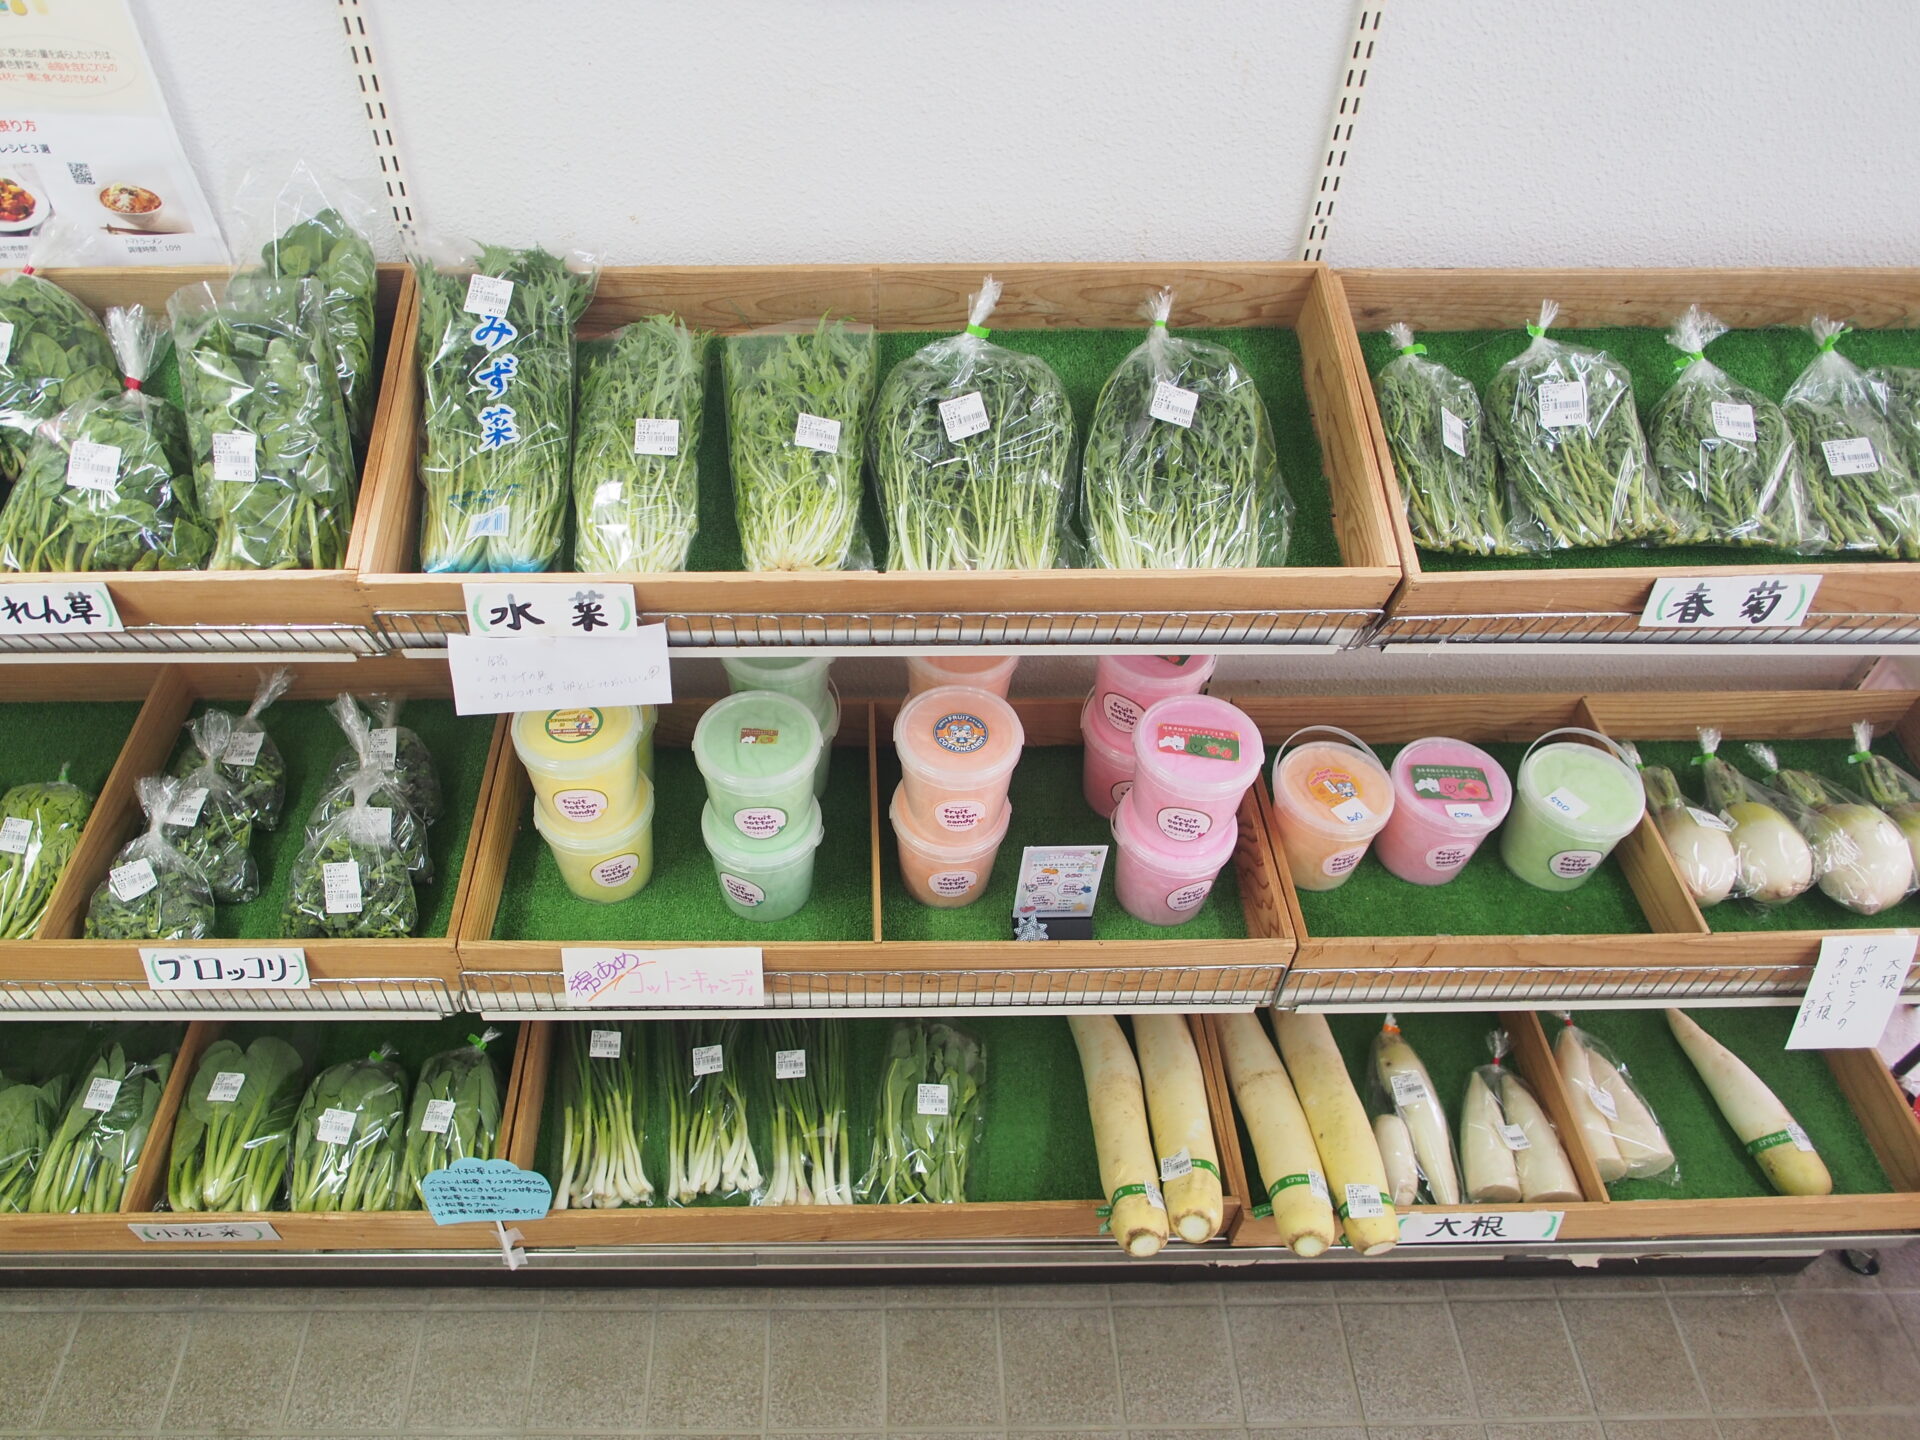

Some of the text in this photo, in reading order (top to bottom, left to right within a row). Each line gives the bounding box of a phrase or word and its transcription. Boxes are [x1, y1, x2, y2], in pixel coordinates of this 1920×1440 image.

[475, 315, 515, 448] みず菜
[1173, 416, 1190, 426] ¥100
[1565, 413, 1582, 421] ¥100
[971, 421, 988, 431] ¥100
[1737, 431, 1754, 439] ¥100
[820, 442, 837, 451] ¥100
[1667, 580, 1788, 624] 春菊
[1, 591, 101, 624] れん草
[490, 590, 609, 632] 水菜
[1110, 707, 1138, 721] cotton
[1113, 703, 1134, 715] fruit
[948, 714, 968, 722] FRUIT
[1113, 714, 1135, 726] candy
[181, 815, 196, 823] ¥100
[1167, 820, 1200, 829] cotton
[1168, 824, 1196, 834] candy
[1332, 858, 1359, 866] cotton
[600, 865, 623, 874] fruit
[601, 867, 631, 878] cotton
[726, 880, 746, 890] fruit
[728, 887, 755, 898] cotton
[1176, 890, 1206, 901] cotton
[1182, 888, 1204, 896] fruit
[735, 894, 754, 902] candy
[1177, 897, 1201, 905] candy
[158, 953, 298, 982] ブロッコリー
[568, 952, 640, 997] 綿あめ
[627, 970, 754, 997] コットンキャンディ
[1425, 1216, 1507, 1237] 大根
